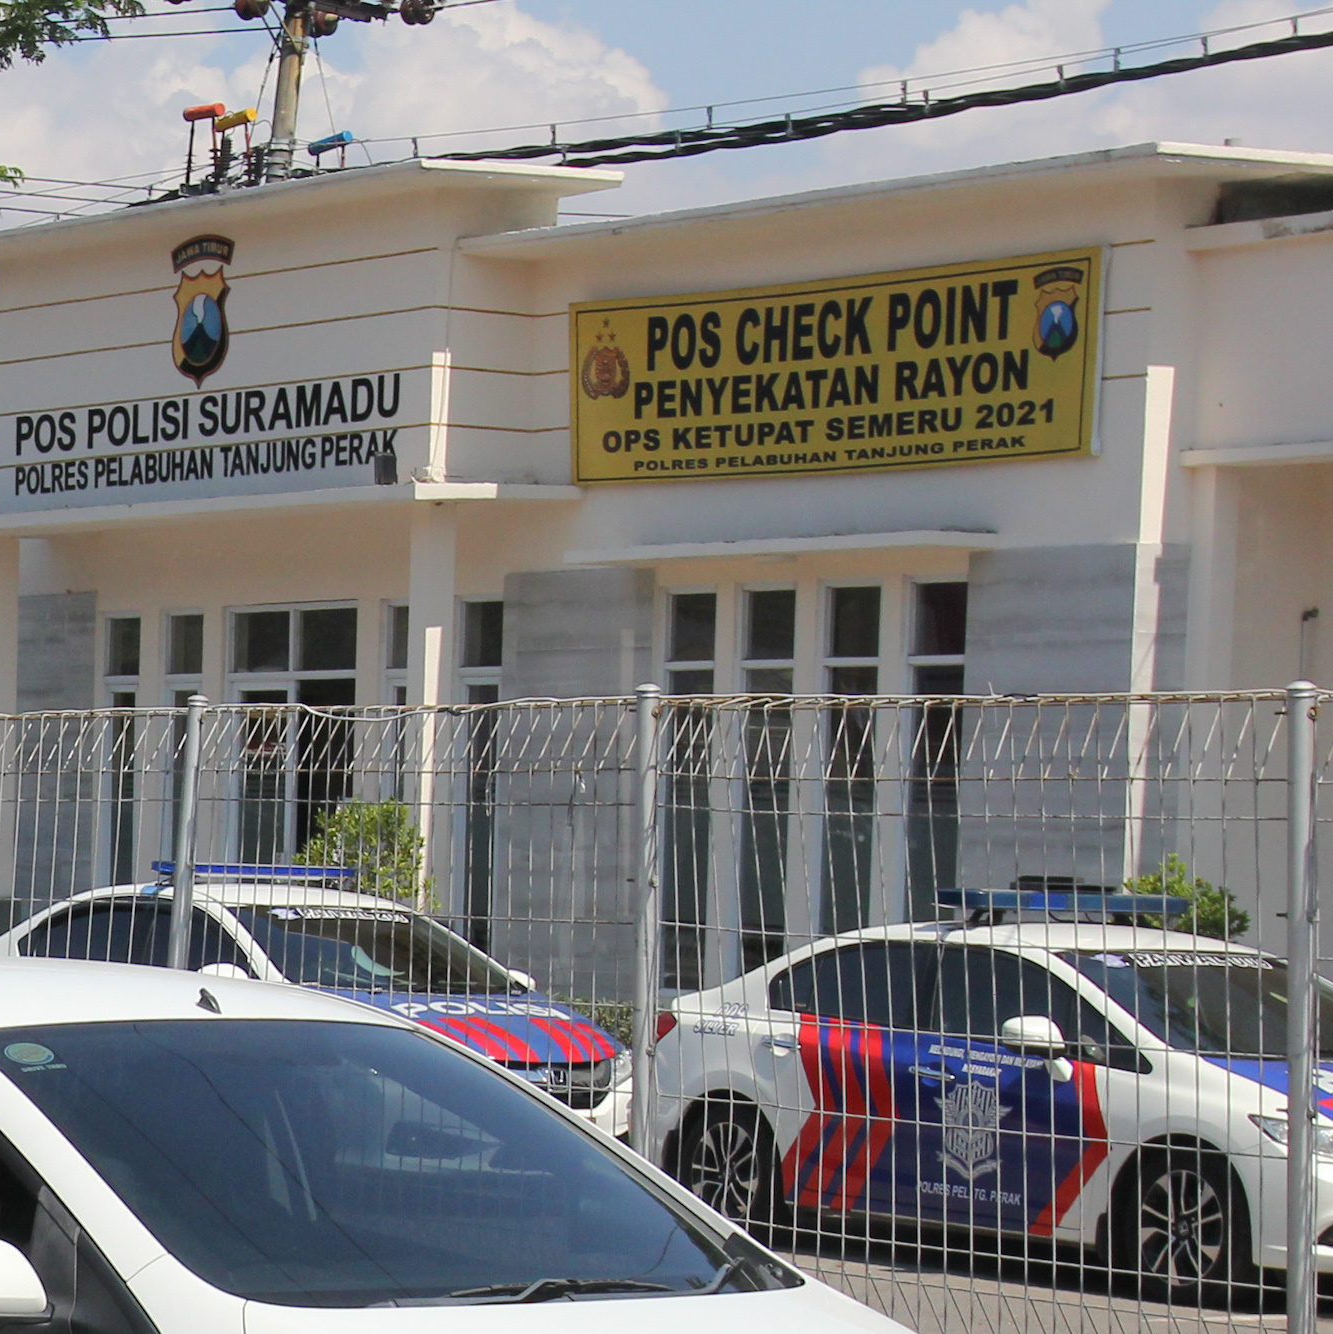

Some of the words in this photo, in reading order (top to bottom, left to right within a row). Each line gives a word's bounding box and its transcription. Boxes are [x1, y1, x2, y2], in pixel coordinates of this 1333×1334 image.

[647, 311, 721, 371] POS
[736, 296, 873, 366] CHECK
[887, 279, 1018, 352] POINT
[15, 411, 76, 456] POS
[87, 398, 189, 449] POLISI
[198, 373, 401, 436] SURAMADU
[634, 364, 879, 420] PENYEKATAN
[894, 348, 1029, 402] RAYON
[603, 428, 660, 453] OPS
[672, 420, 814, 450] KETUPAT
[825, 406, 962, 442] SEMERU
[975, 398, 1054, 429] 2021
[634, 458, 708, 471] POLRES
[715, 451, 837, 468] PELABUHAN
[844, 442, 944, 461] TANJUNG
[952, 435, 1026, 453] PERAK
[14, 460, 88, 496] POLRES
[94, 448, 213, 489] PELABUHAN
[220, 438, 316, 478] TANJUNG
[321, 429, 400, 468] PERAK
[391, 1001, 572, 1021] POLISI
[693, 1019, 740, 1036] SILVER
